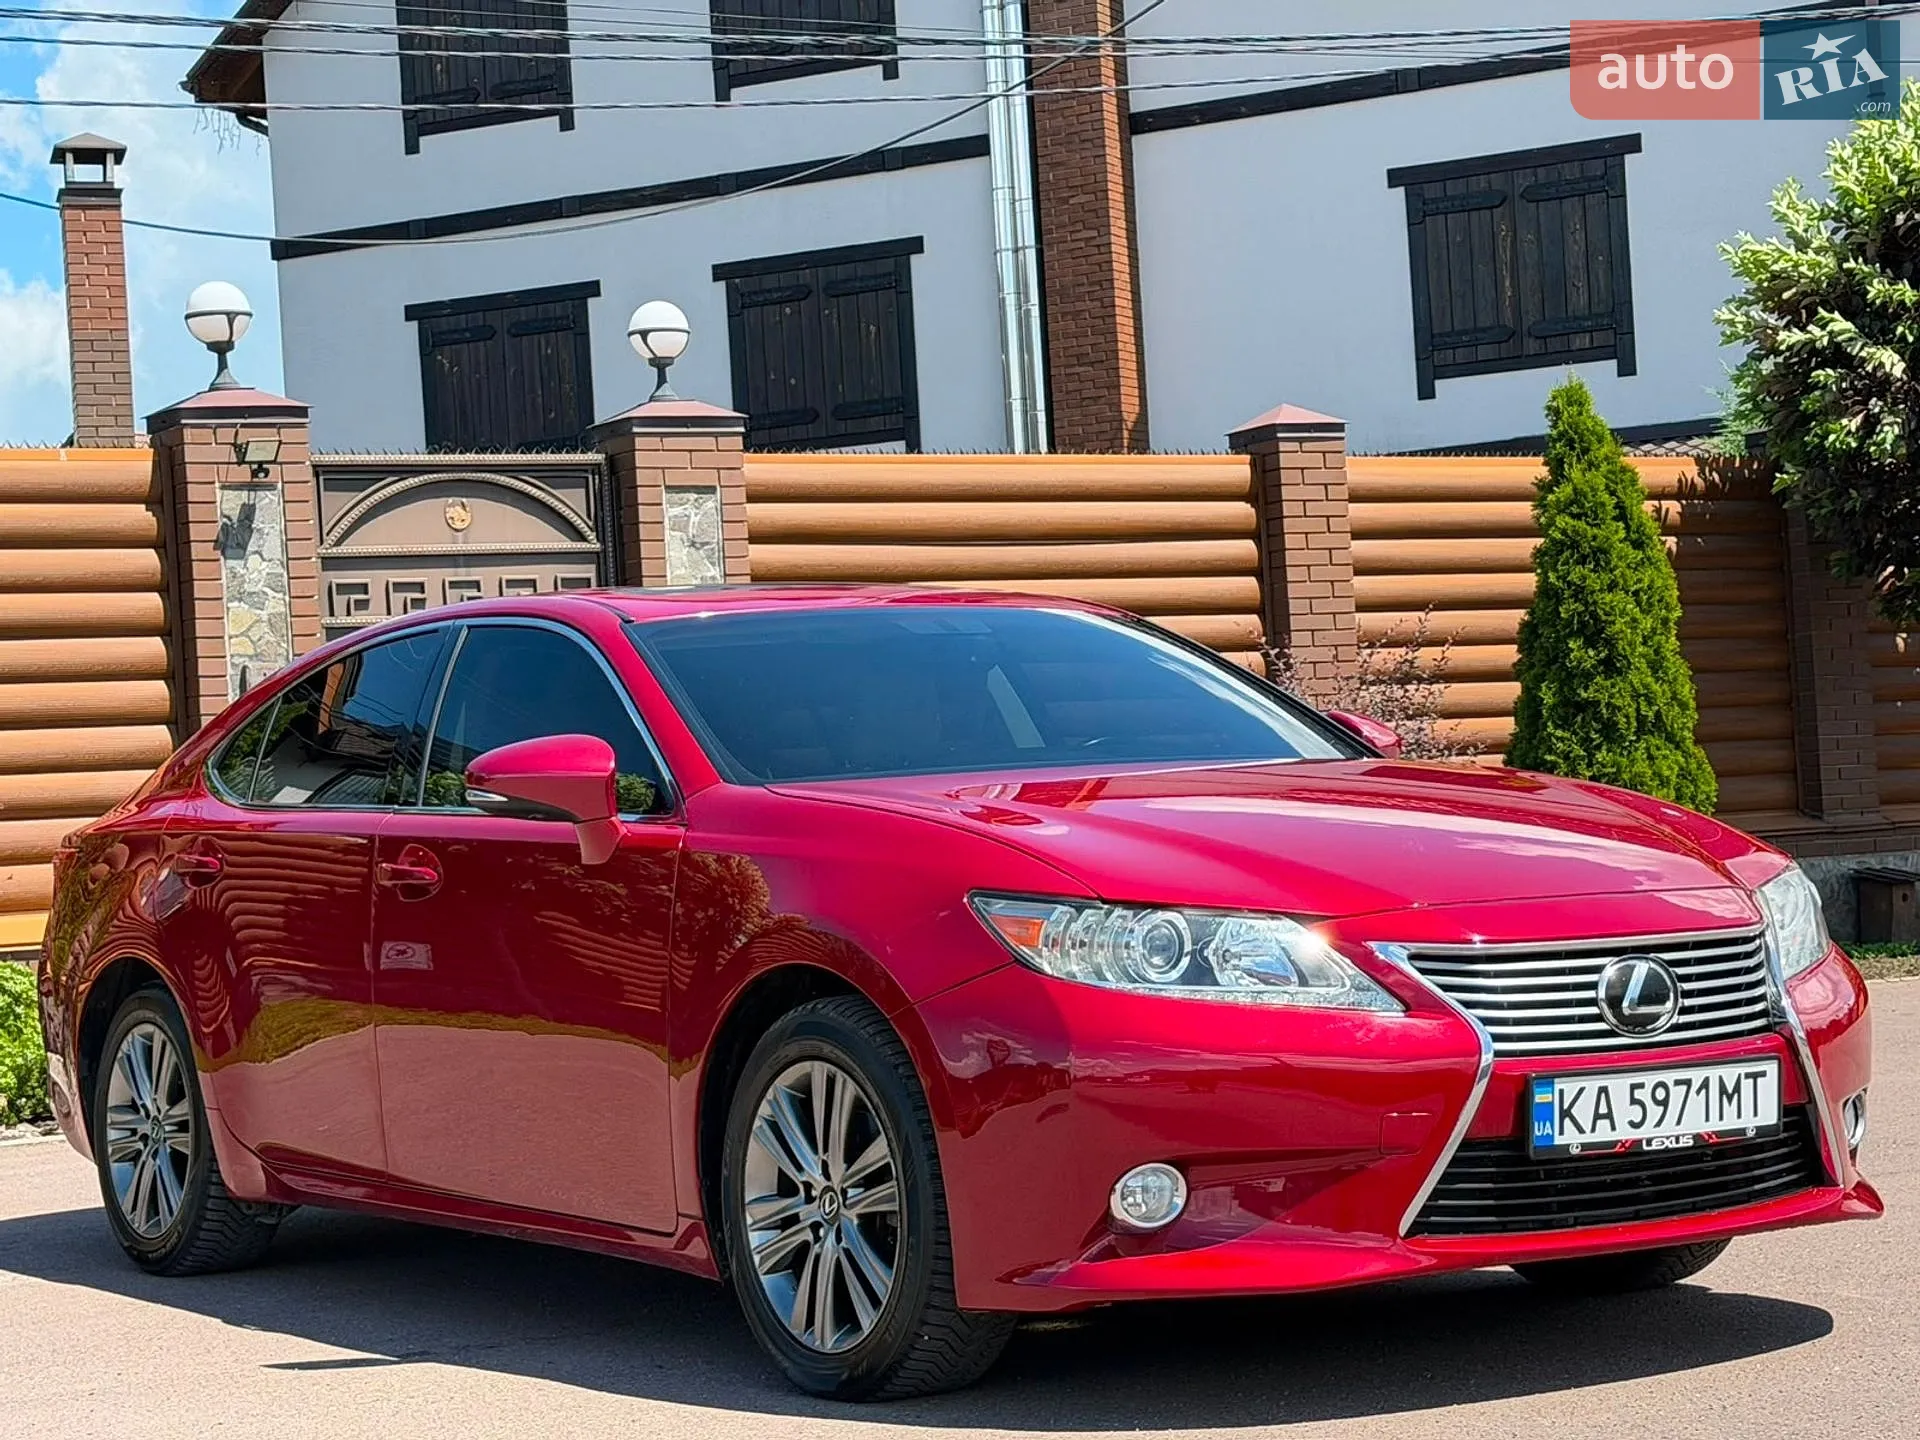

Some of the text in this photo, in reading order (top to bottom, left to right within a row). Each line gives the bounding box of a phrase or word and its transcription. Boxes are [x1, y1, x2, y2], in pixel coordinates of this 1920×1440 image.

[1558, 1085, 1617, 1136] KA
[1534, 1120, 1553, 1136] UA
[1642, 1134, 1694, 1150] LEXUS
